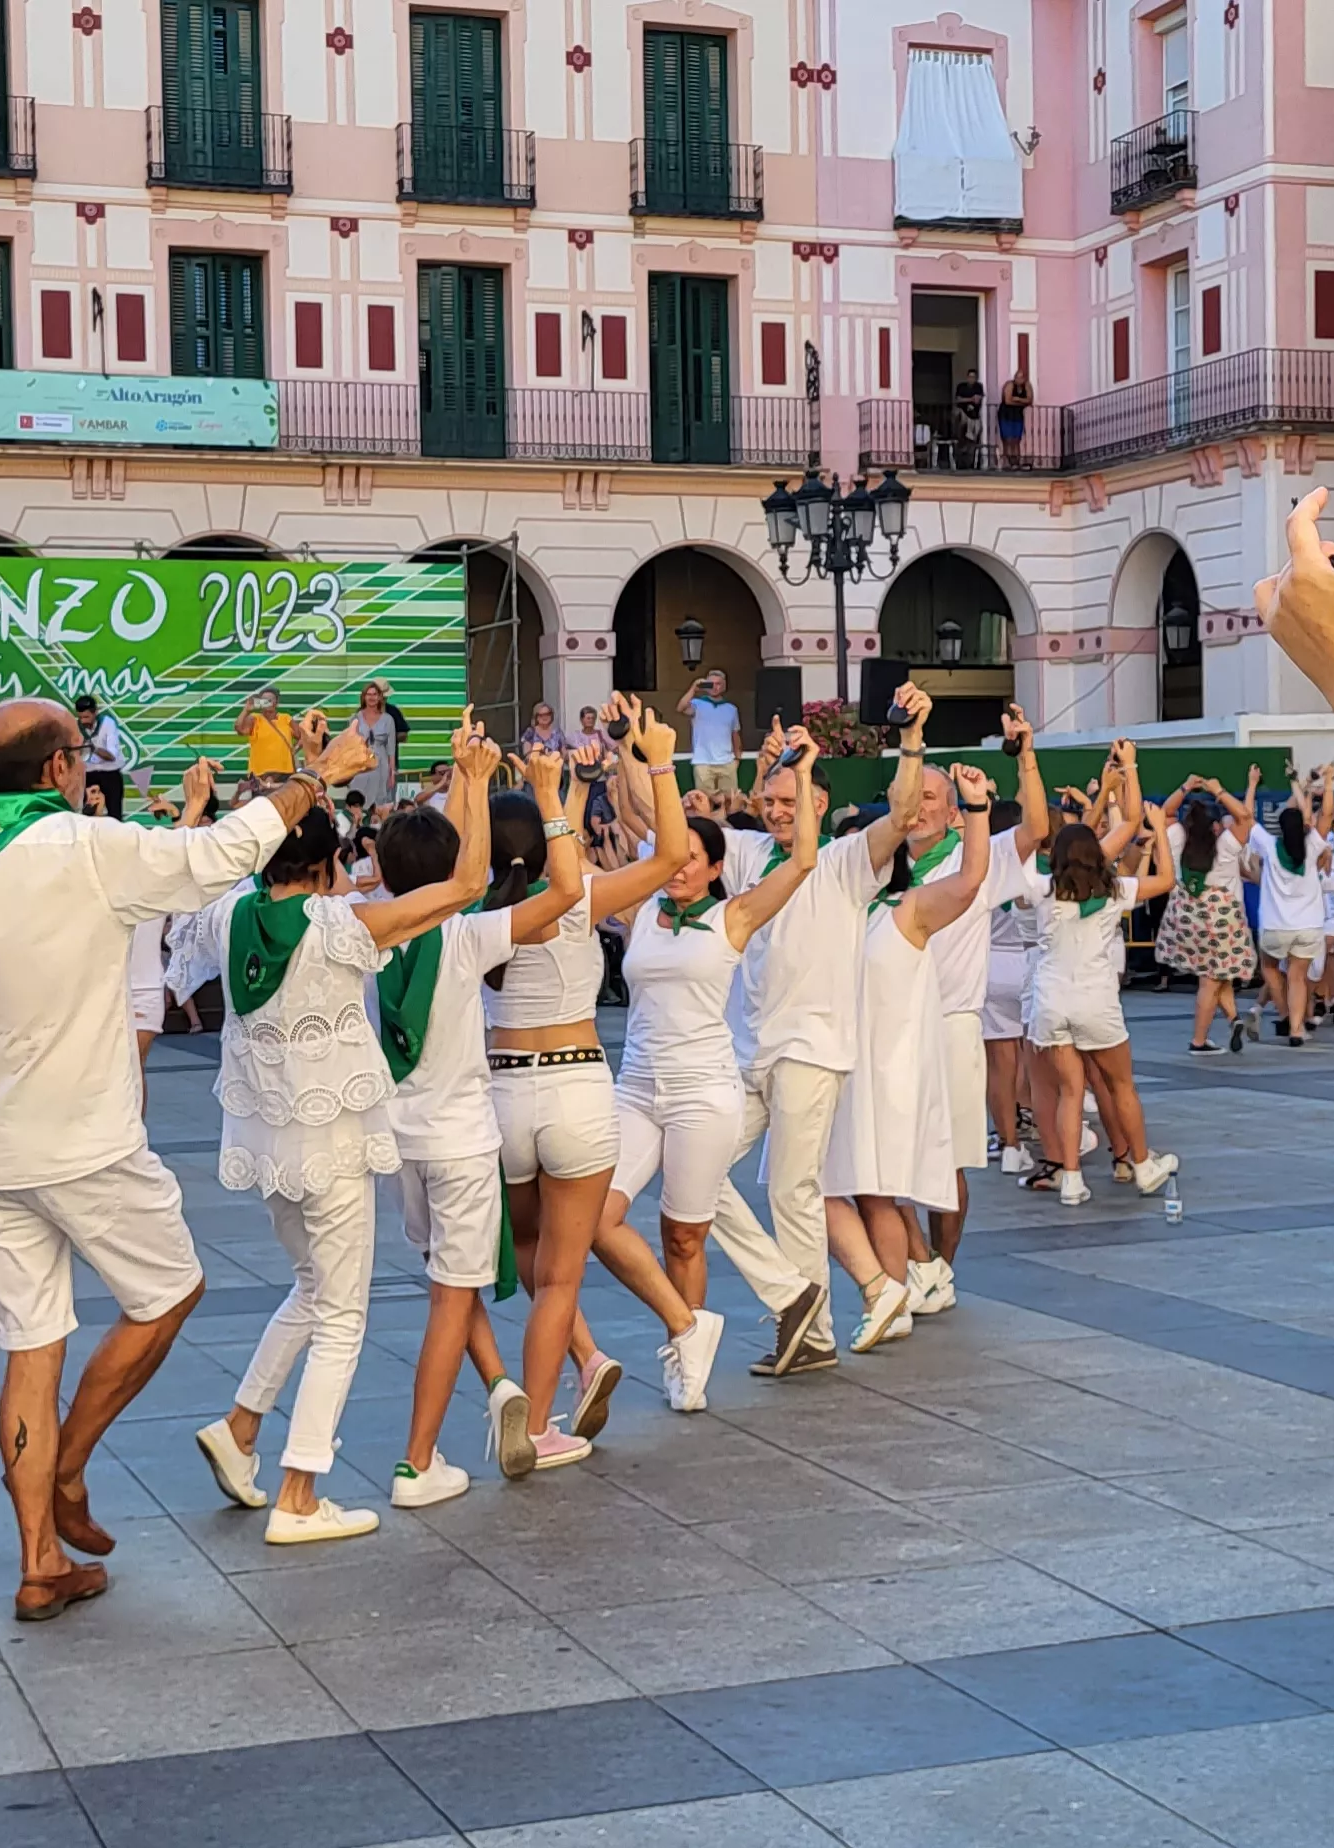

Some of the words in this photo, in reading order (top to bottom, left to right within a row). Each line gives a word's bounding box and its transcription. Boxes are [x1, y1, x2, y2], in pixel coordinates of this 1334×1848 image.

[107, 387, 203, 406] AltoAragón
[87, 419, 129, 430] AMBAR
[198, 569, 347, 652] 2023
[57, 656, 188, 702] más
